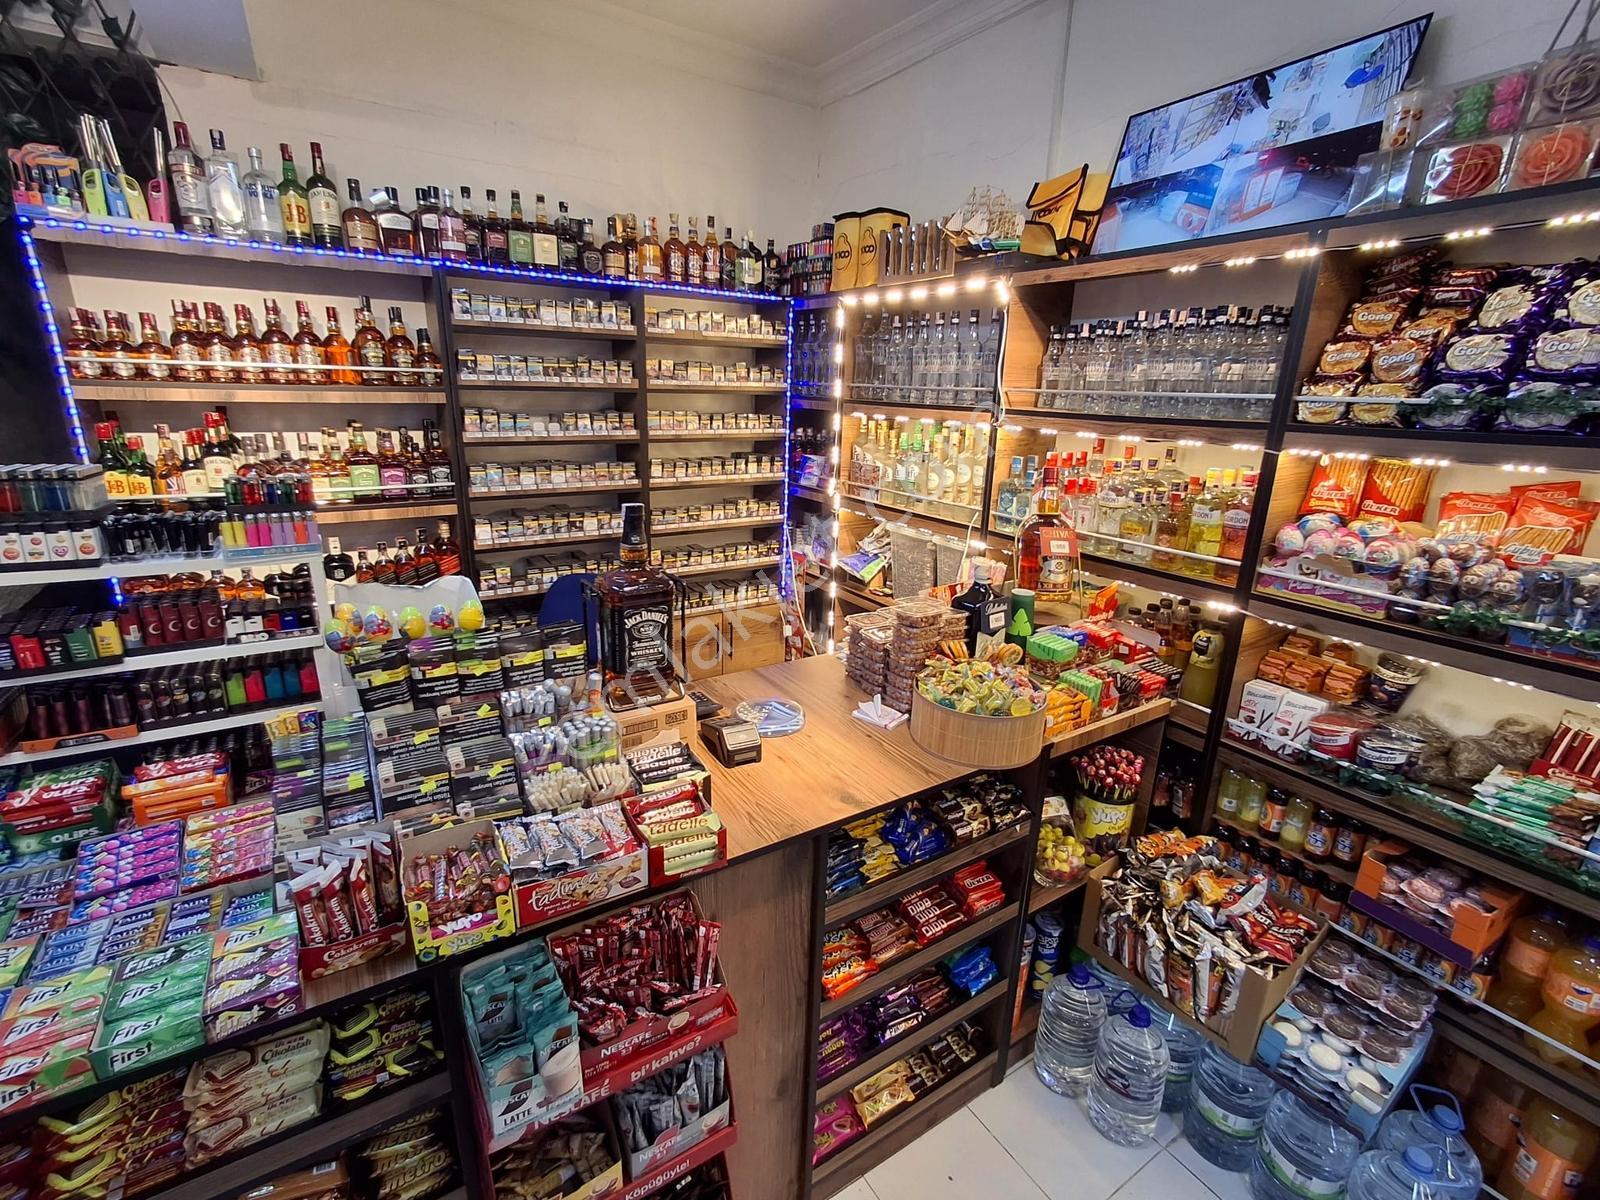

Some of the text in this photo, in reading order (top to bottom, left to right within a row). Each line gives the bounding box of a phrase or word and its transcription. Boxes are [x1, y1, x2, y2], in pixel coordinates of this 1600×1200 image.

[1578, 292, 1600, 302] Go
[1358, 311, 1393, 321] Gong
[1327, 351, 1360, 362] Gong
[1379, 352, 1416, 366] Gong
[1362, 501, 1399, 515] ÜLKER
[624, 610, 669, 629] JACK DANIEL'S
[631, 647, 662, 657] WHISKEY
[42, 785, 91, 799] OLIPS
[50, 827, 102, 844] OLIPS
[649, 817, 709, 836] tadelle
[965, 874, 994, 888] ÜLKER
[173, 897, 210, 914] FALIM
[227, 901, 261, 916] FALIM
[116, 911, 153, 926] FALIM
[921, 918, 948, 937] DIDO
[223, 925, 265, 947] First
[867, 922, 893, 940] Albeni
[124, 947, 176, 974] First
[271, 948, 291, 959] 60
[121, 977, 170, 1002] First
[270, 975, 291, 986] 60
[19, 981, 72, 1008] First
[278, 1003, 297, 1016] 60
[4, 1012, 60, 1043] First
[111, 1015, 164, 1044] First
[109, 1041, 153, 1069] First
[651, 1036, 703, 1071] kahve?
[0, 1051, 51, 1078] First
[0, 1079, 37, 1102] irst
[503, 1107, 533, 1127] LATTE
[383, 1149, 447, 1193] metro
